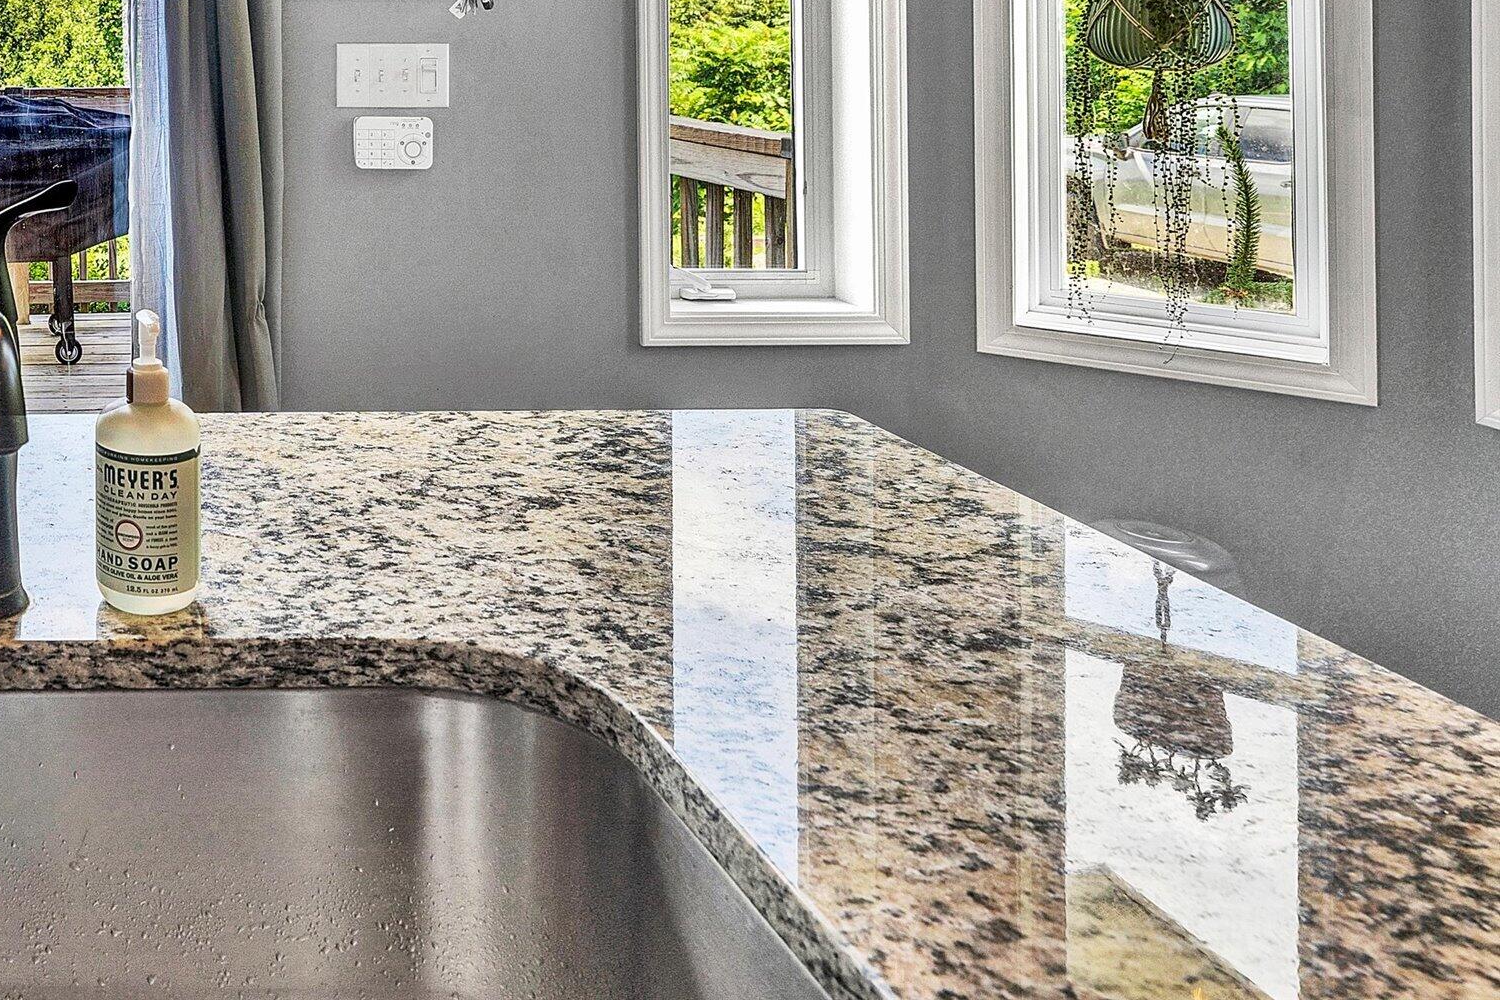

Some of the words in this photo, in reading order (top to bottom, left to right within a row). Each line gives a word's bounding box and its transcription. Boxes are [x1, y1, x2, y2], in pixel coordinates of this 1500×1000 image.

[103, 484, 145, 500] CLEAN
[150, 491, 178, 500] DAY
[127, 556, 179, 571] SOAP
[126, 585, 142, 593] 12.5
